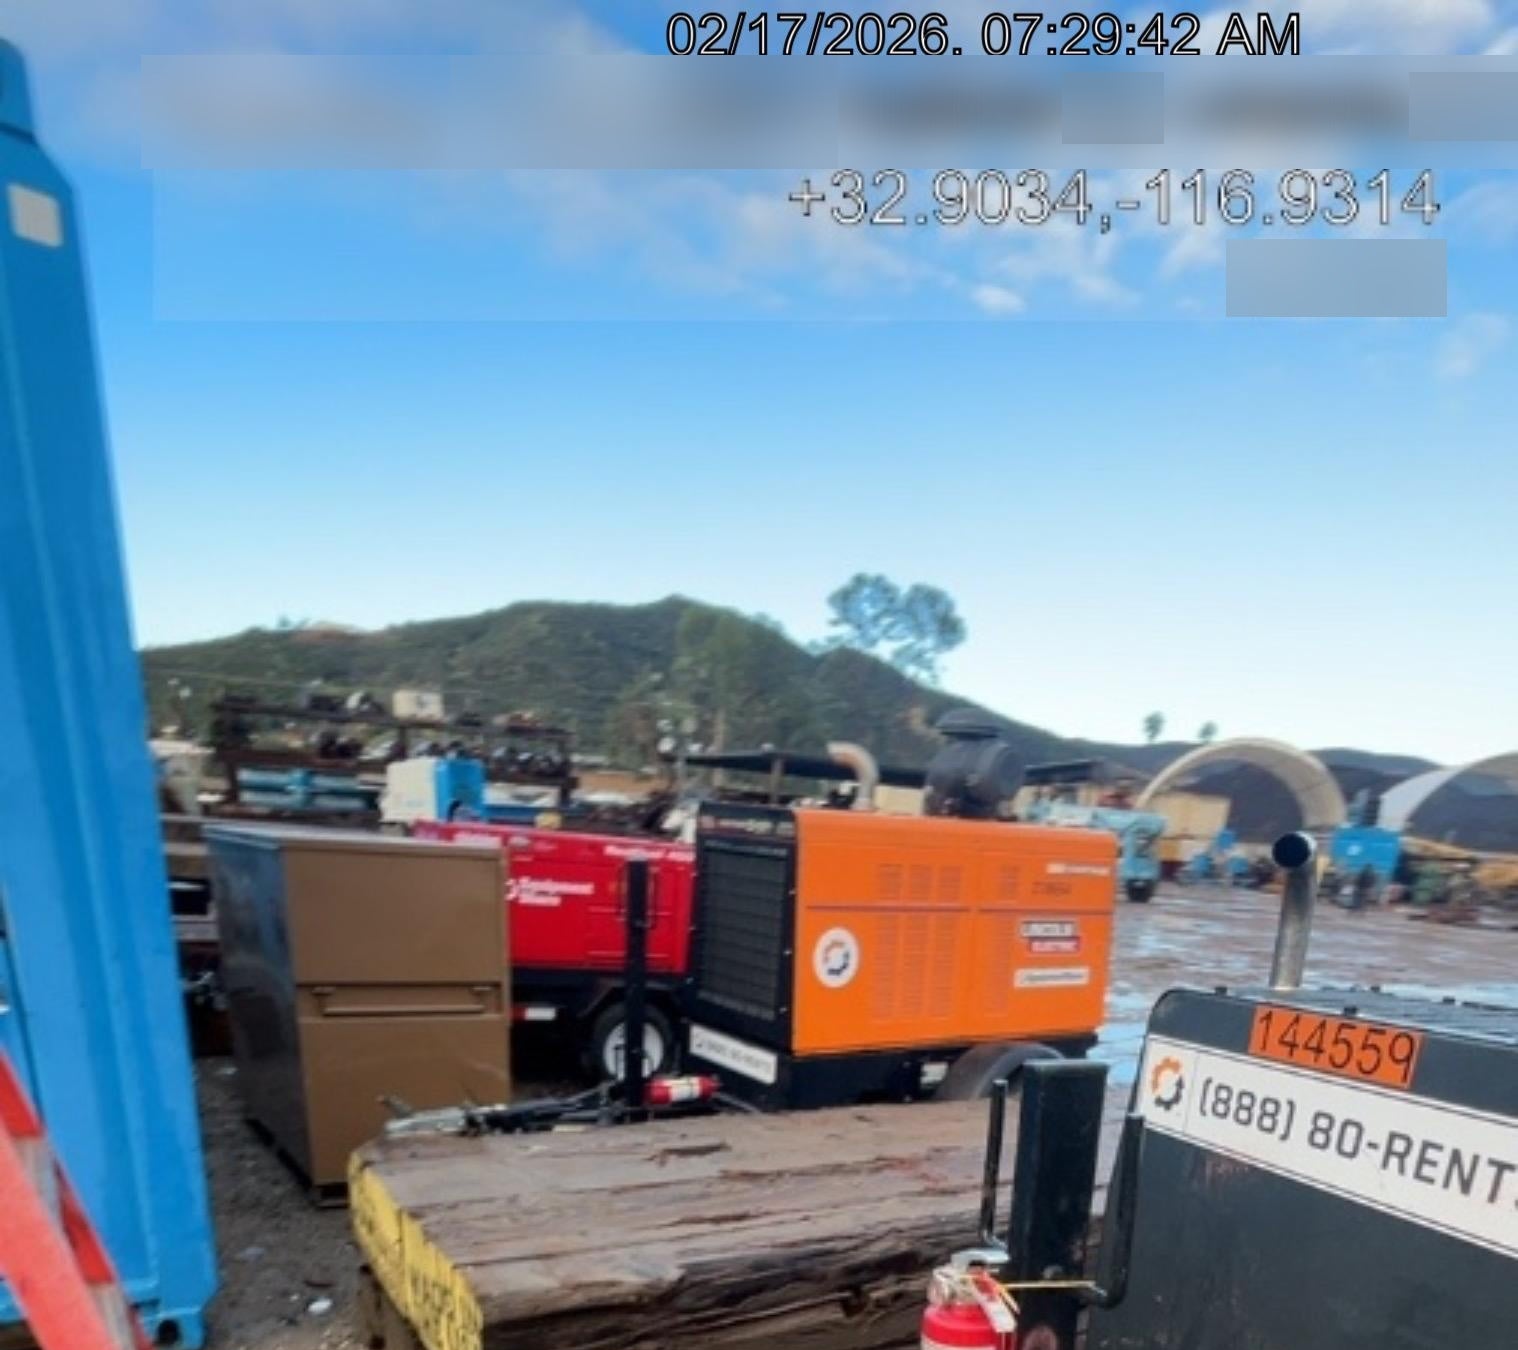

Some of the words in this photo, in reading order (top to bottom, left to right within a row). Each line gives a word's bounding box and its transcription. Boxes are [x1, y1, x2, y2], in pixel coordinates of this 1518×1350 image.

[1258, 1010, 1415, 1083] 144559
[1200, 1077, 1296, 1141] (888)
[1308, 1111, 1518, 1212] 80-RENT
